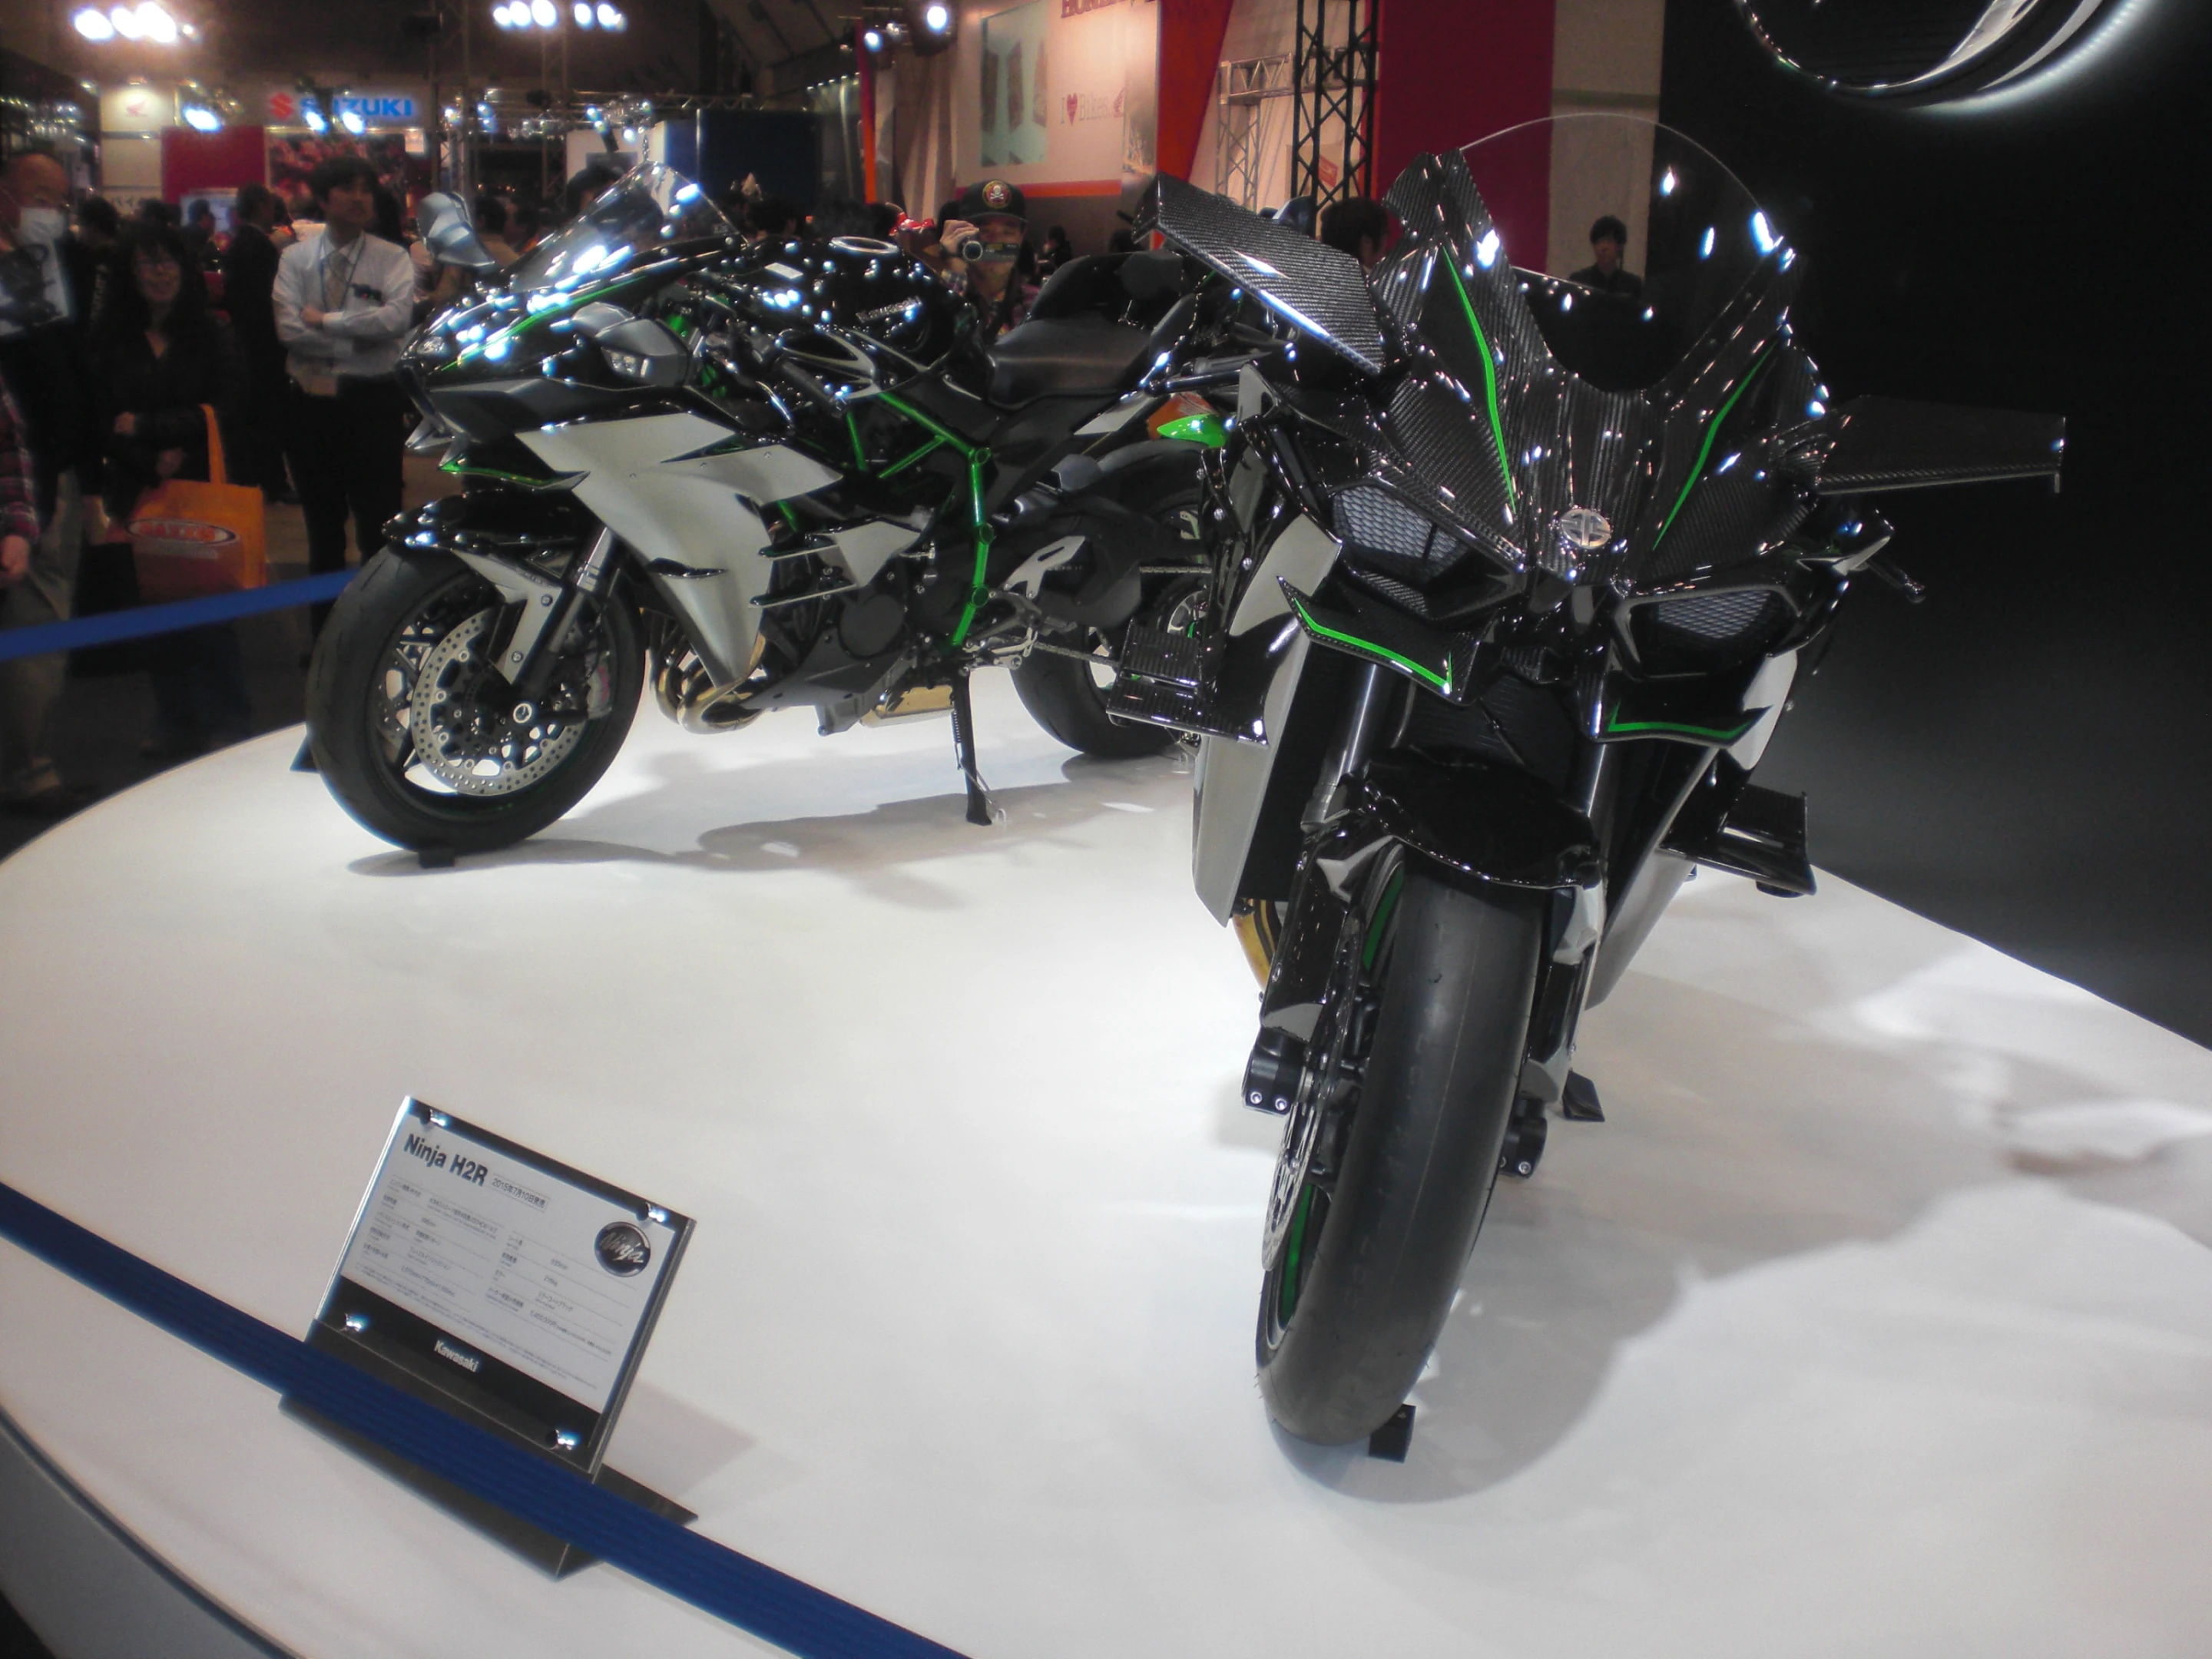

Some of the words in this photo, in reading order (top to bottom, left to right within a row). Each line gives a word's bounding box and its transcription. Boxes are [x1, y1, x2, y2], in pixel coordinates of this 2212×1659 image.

[403, 1133, 447, 1167] Ninja
[449, 1154, 488, 1187] H2R
[601, 1232, 644, 1263] Ninja
[434, 1339, 479, 1373] Kawasaki
